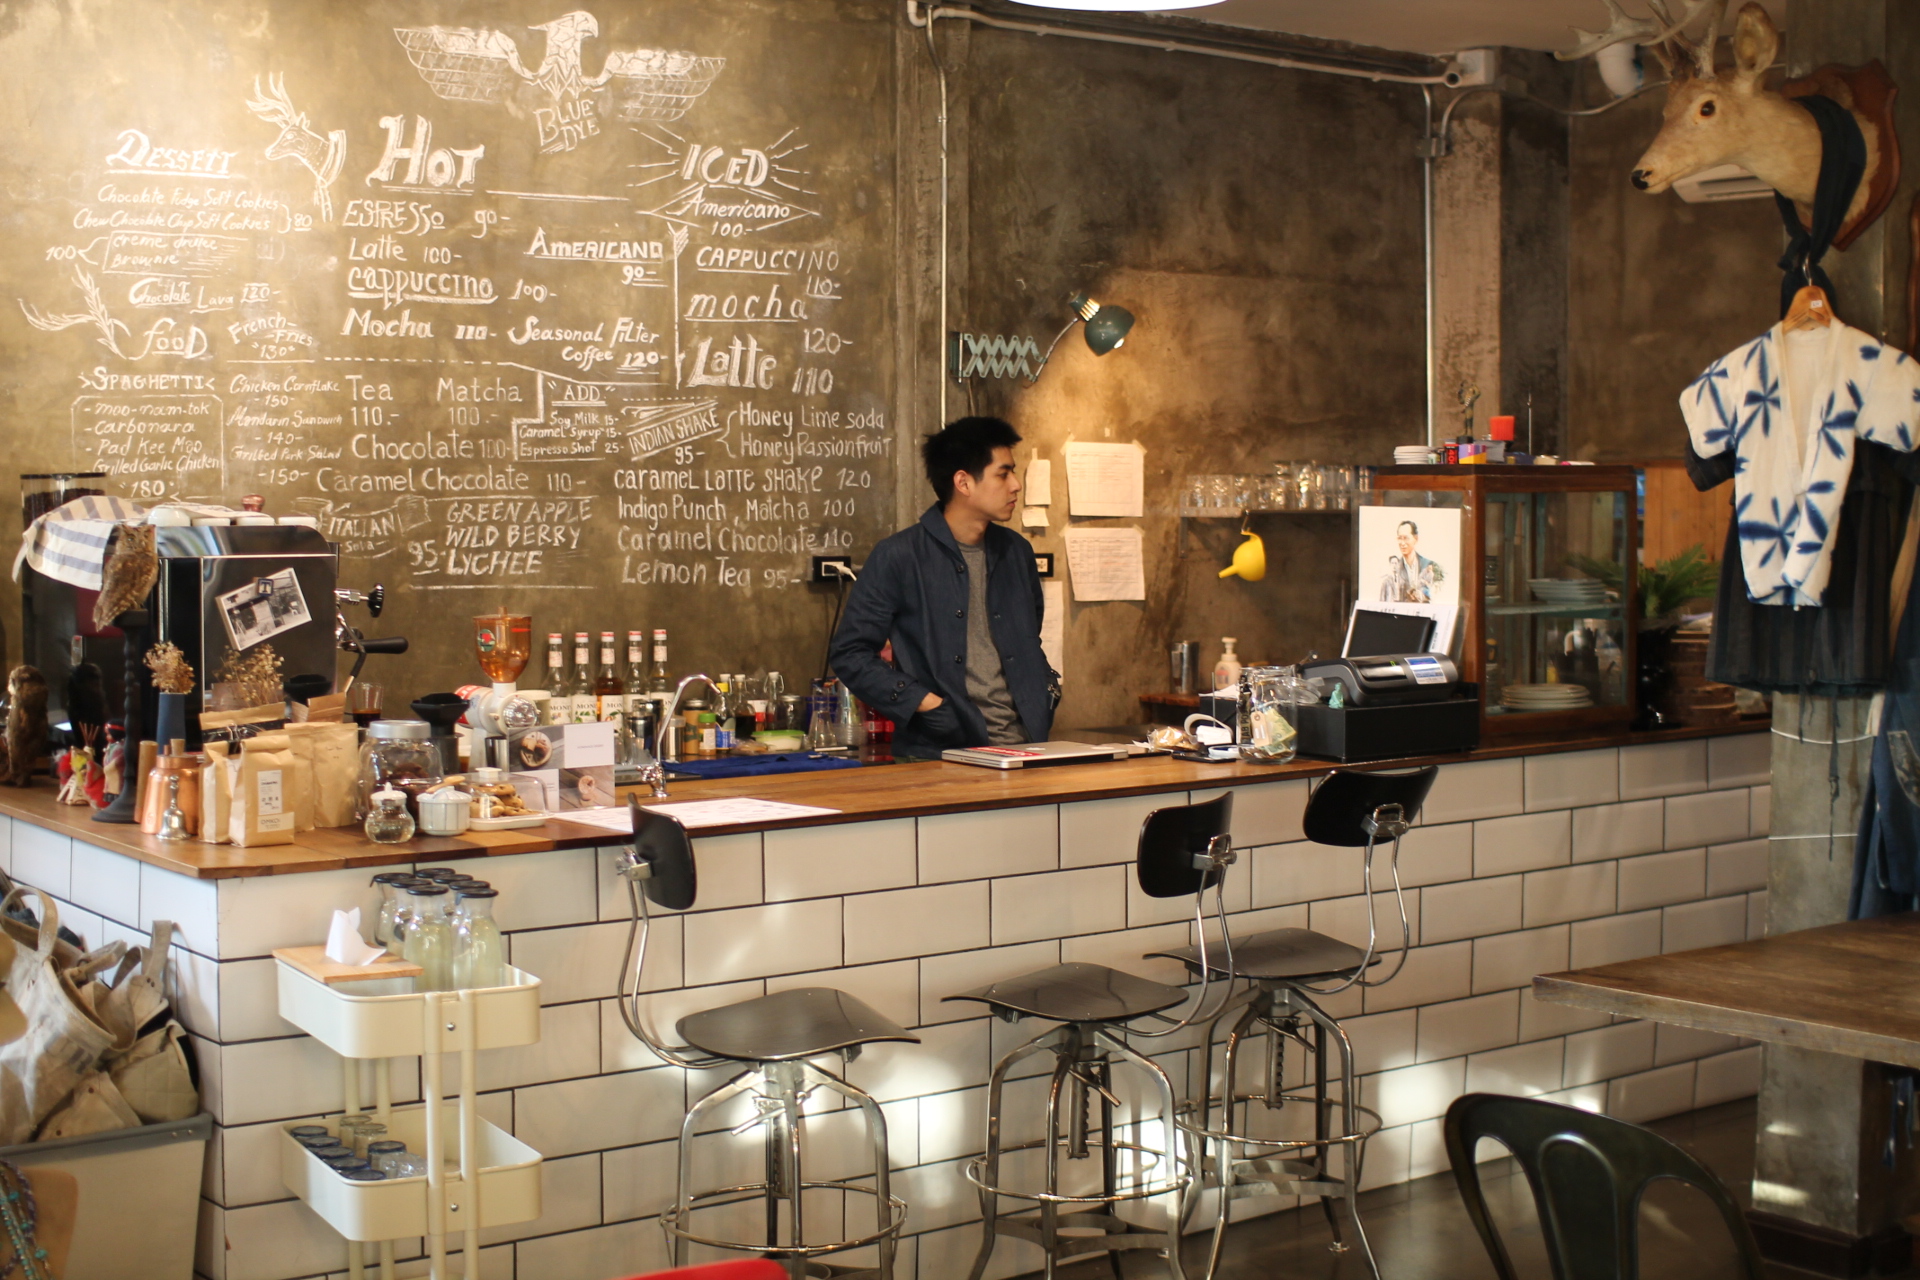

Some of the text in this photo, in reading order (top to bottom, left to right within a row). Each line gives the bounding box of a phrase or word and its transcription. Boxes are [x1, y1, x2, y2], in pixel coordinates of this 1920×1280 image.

[98, 184, 164, 204] Chocolate
[234, 191, 278, 210] Cookies
[222, 213, 270, 231] Cookies
[293, 215, 313, 227] 80
[46, 245, 77, 261] 100
[348, 235, 407, 262] Latte
[696, 245, 839, 274] CAPPUCCINO
[341, 307, 434, 337] Mocha
[229, 374, 280, 394] Chicken
[345, 375, 522, 402] Tea Matcha
[792, 367, 834, 396] 110
[550, 410, 571, 429] Soy
[575, 412, 600, 425] Milk
[801, 404, 839, 427] Lime
[847, 407, 885, 429] soda
[629, 407, 720, 454] INDIAN SHAKE
[98, 435, 132, 456] Pad
[137, 438, 166, 455] Kee
[352, 430, 474, 460] Chocolate
[521, 442, 568, 459] Espresso
[315, 466, 416, 492] Caramel
[421, 465, 529, 491] Chocolate
[837, 469, 870, 489] 120
[329, 512, 395, 537] ITALIAN
[447, 500, 592, 524] GREEN APPLE
[619, 496, 668, 530] Indigo
[824, 497, 854, 517] 100
[445, 525, 581, 549] WILD BERRY
[618, 523, 711, 551] Caramel
[446, 550, 542, 576] LYCHEE
[622, 556, 706, 584] Lemon
[716, 556, 751, 587] Tea
